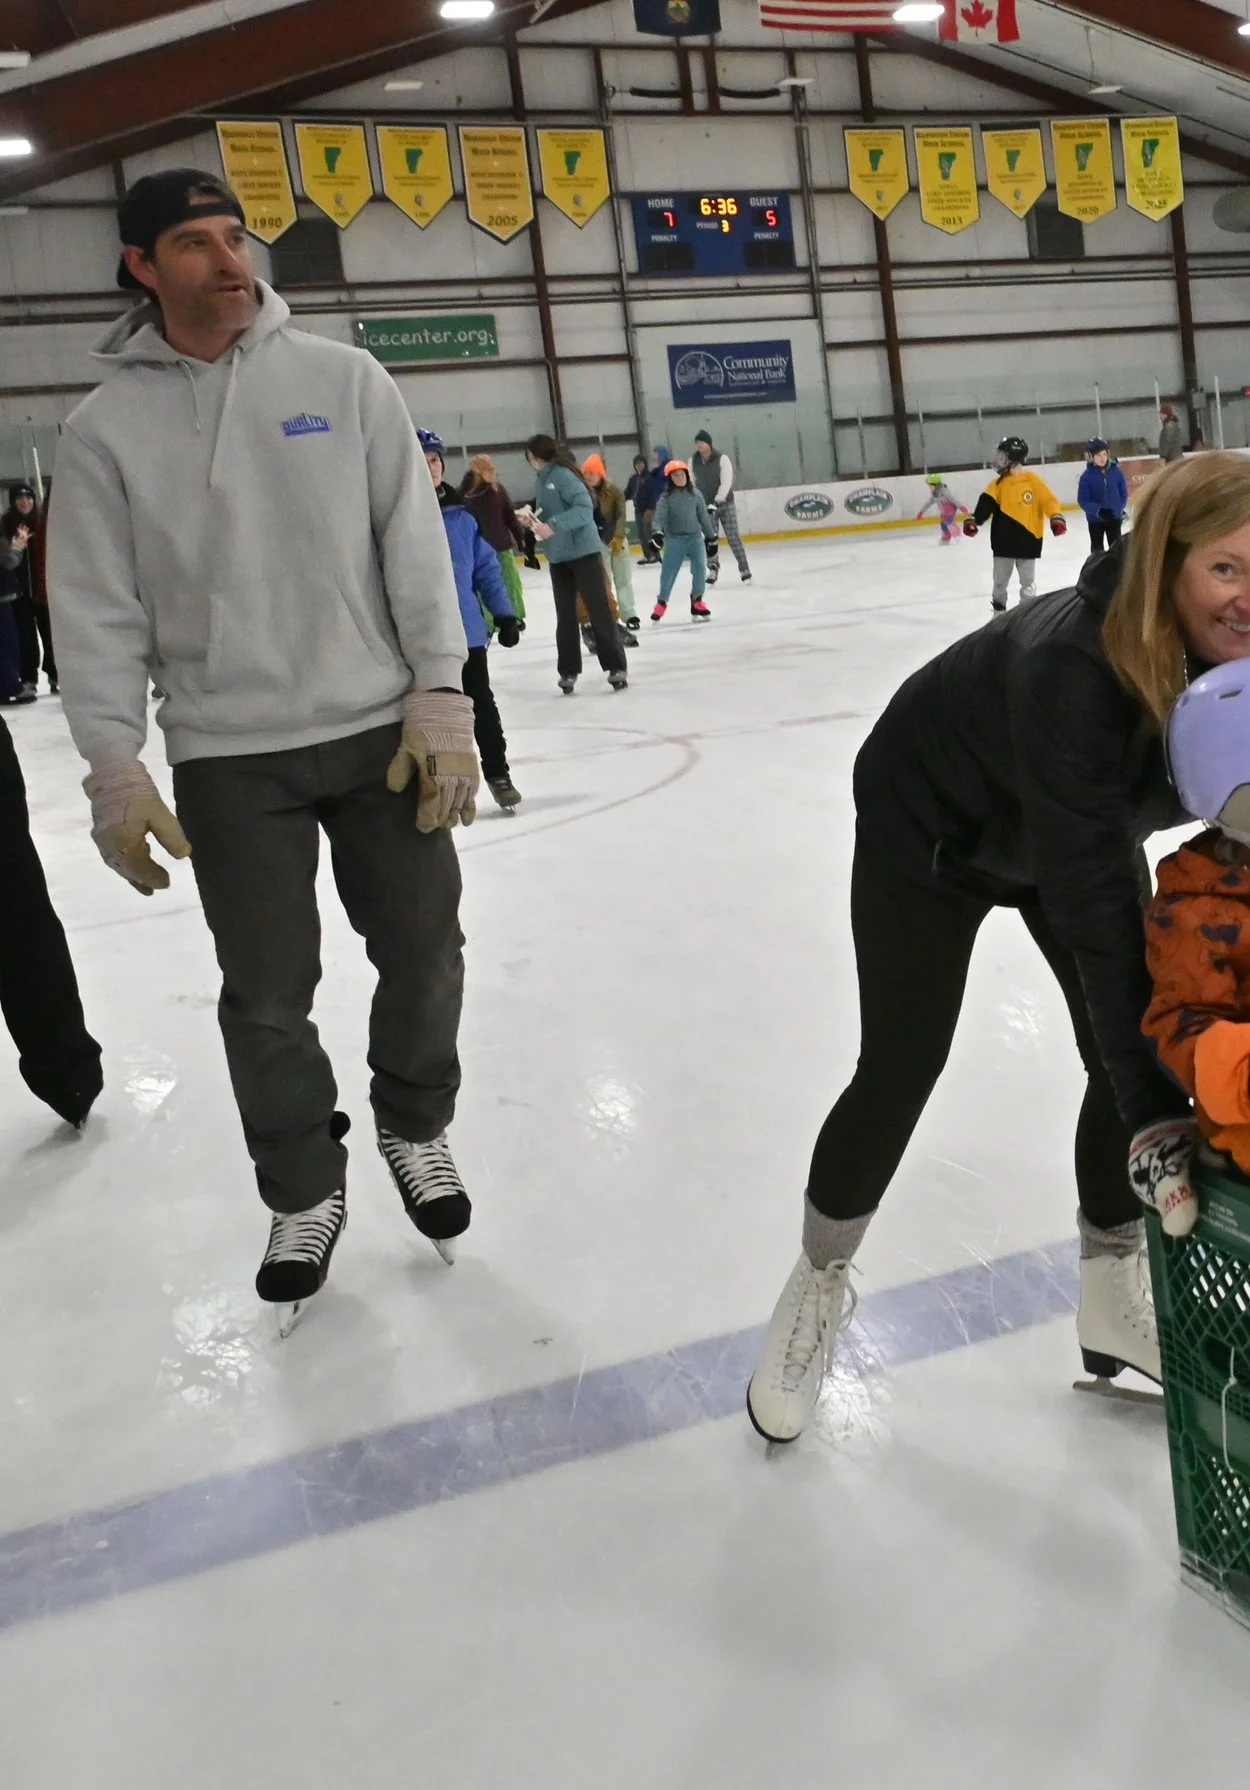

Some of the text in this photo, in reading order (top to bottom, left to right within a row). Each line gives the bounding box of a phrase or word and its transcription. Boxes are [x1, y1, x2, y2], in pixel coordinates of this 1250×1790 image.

[648, 199, 675, 208] HOME
[700, 198, 738, 216] 6:36
[750, 196, 778, 207] GUEST
[1077, 206, 1099, 216] 2020
[252, 216, 283, 229] 1990
[487, 215, 518, 226] 2005
[664, 211, 675, 227] 7
[766, 209, 777, 226] 5
[940, 216, 963, 226] 2013
[721, 219, 730, 233] 3
[652, 234, 678, 242] PENALTY
[755, 231, 780, 241] PENALTY
[363, 329, 489, 347] icecenter.org
[723, 354, 789, 371] Community
[727, 367, 786, 382] National Bank
[855, 504, 883, 513] FARMS
[796, 509, 825, 520] FARMS
